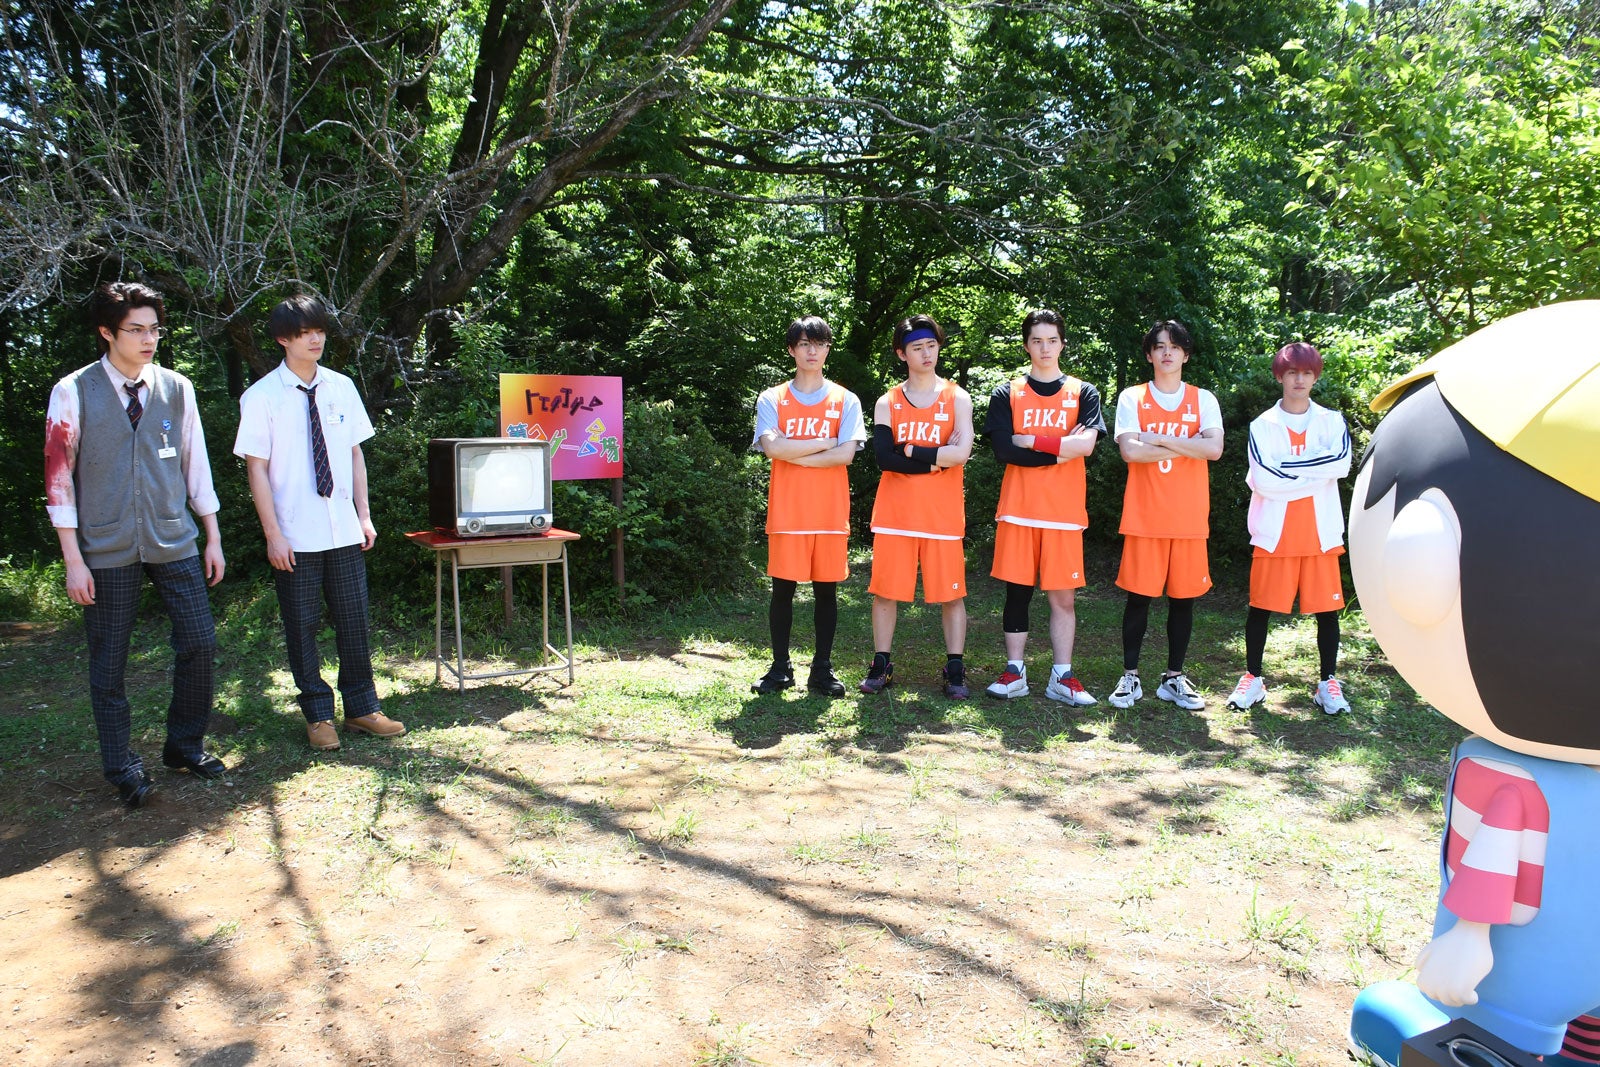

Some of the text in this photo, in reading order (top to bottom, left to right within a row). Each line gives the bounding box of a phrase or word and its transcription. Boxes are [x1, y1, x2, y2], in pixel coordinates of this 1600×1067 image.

[785, 417, 831, 439] EIKA
[1022, 408, 1068, 430] EIKA
[897, 421, 941, 445] EIKA
